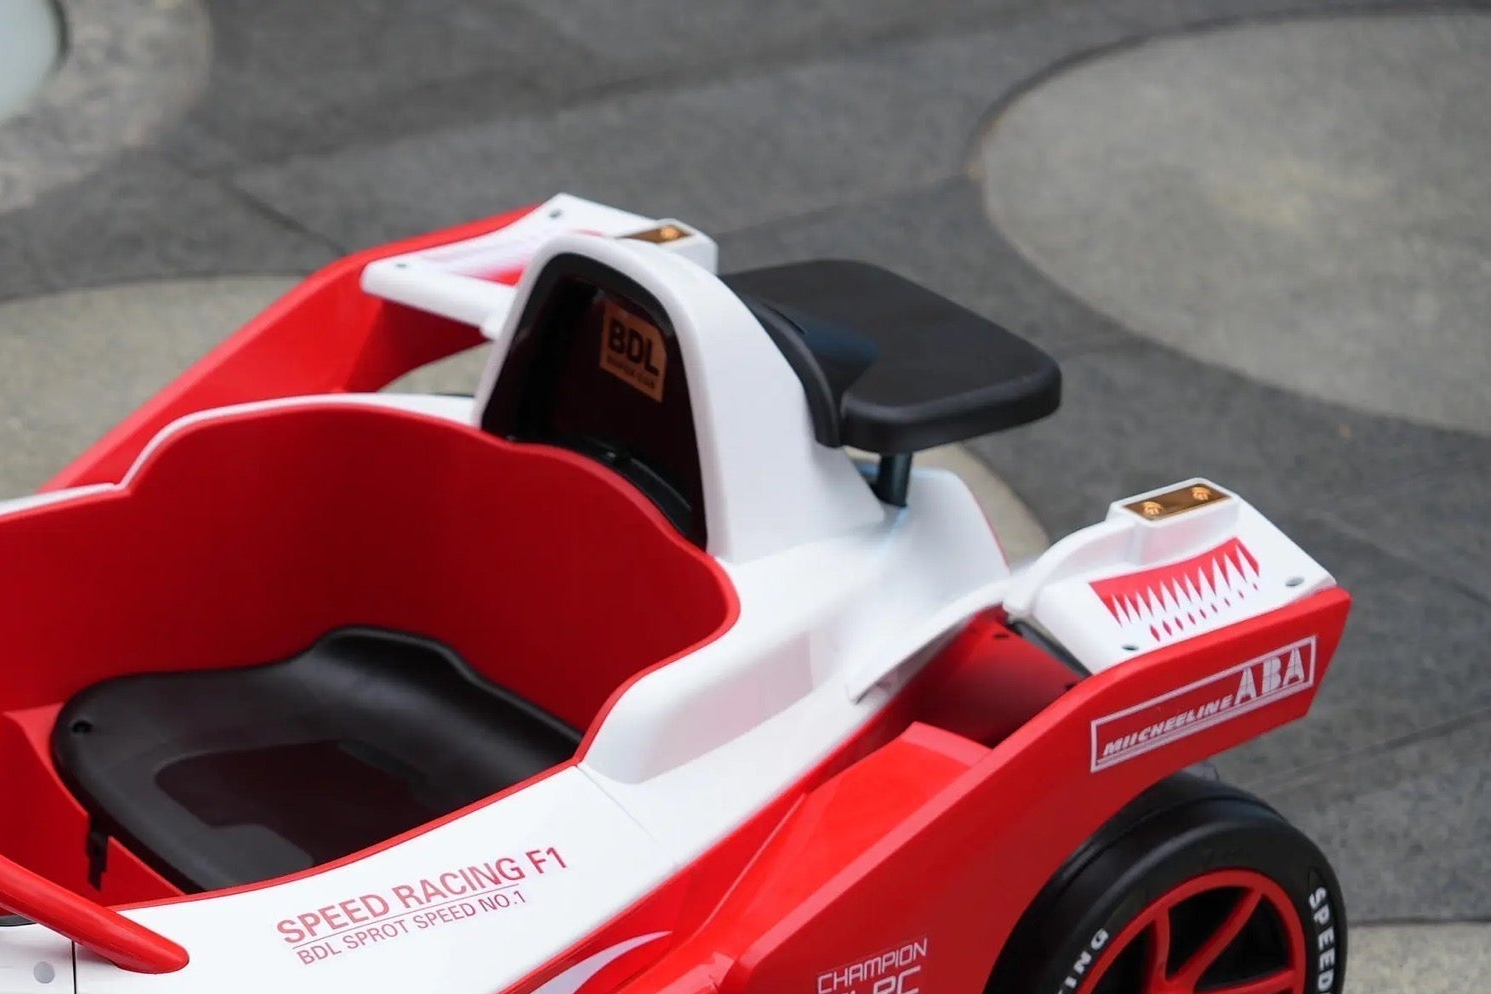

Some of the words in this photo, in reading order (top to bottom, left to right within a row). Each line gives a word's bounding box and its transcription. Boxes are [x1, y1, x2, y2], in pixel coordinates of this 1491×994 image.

[608, 317, 659, 377] BDL
[1235, 647, 1305, 706] ABA
[276, 893, 390, 945] SPEED
[392, 856, 526, 909] RACING
[524, 846, 568, 876] F1
[296, 942, 342, 966] BDL
[342, 918, 408, 951] SPROT
[412, 901, 477, 931] SPEED
[478, 889, 527, 913] NO.1
[818, 938, 928, 994] CHAMPION
